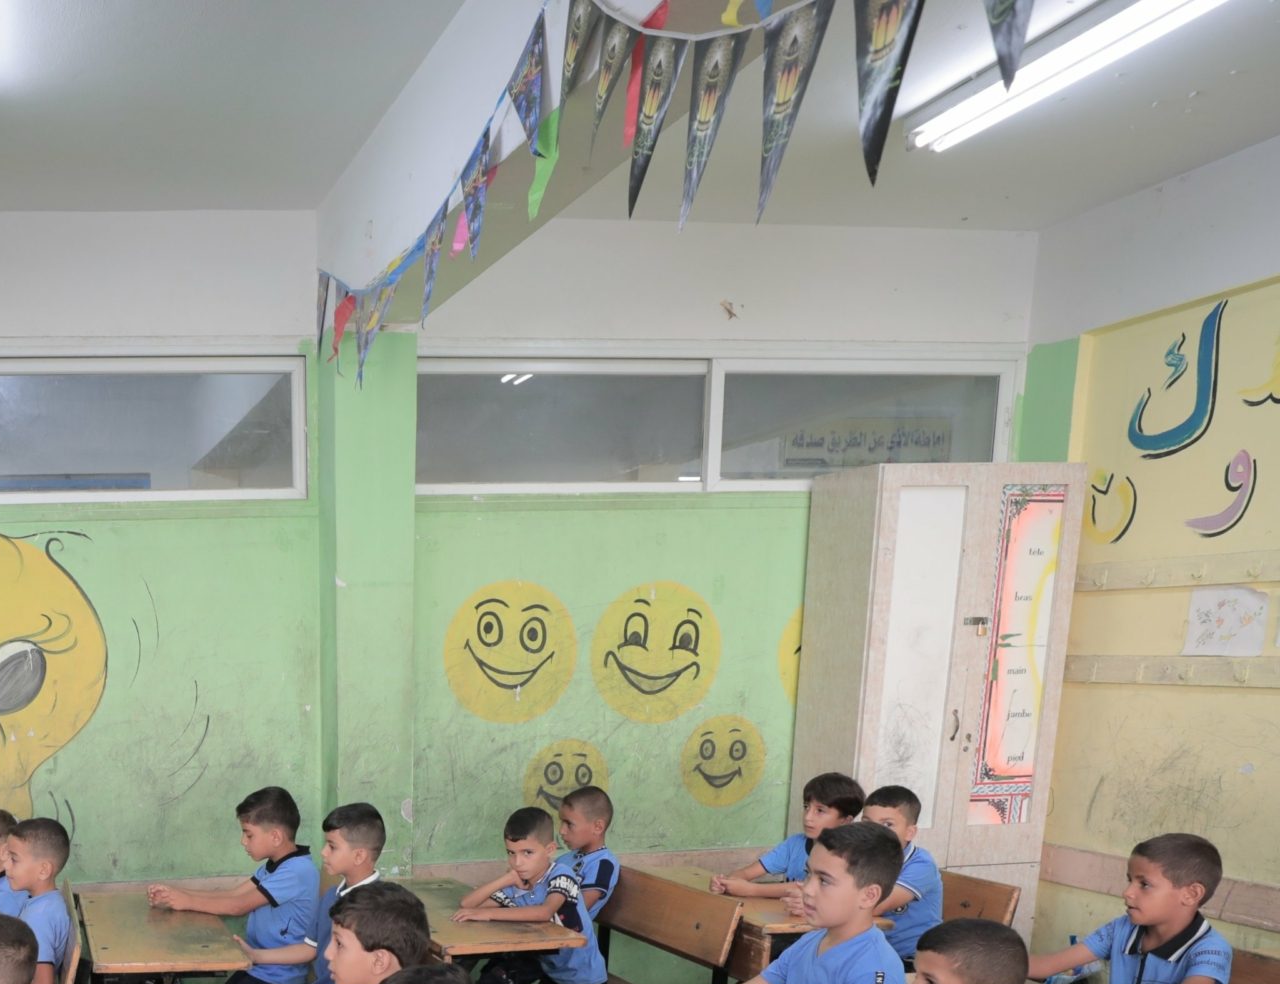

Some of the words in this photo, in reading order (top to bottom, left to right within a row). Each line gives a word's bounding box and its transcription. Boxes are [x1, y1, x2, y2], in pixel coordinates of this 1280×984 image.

[1128, 299, 1228, 459] ك
[1184, 449, 1257, 538] و
[1007, 708, 1032, 721] jambe
